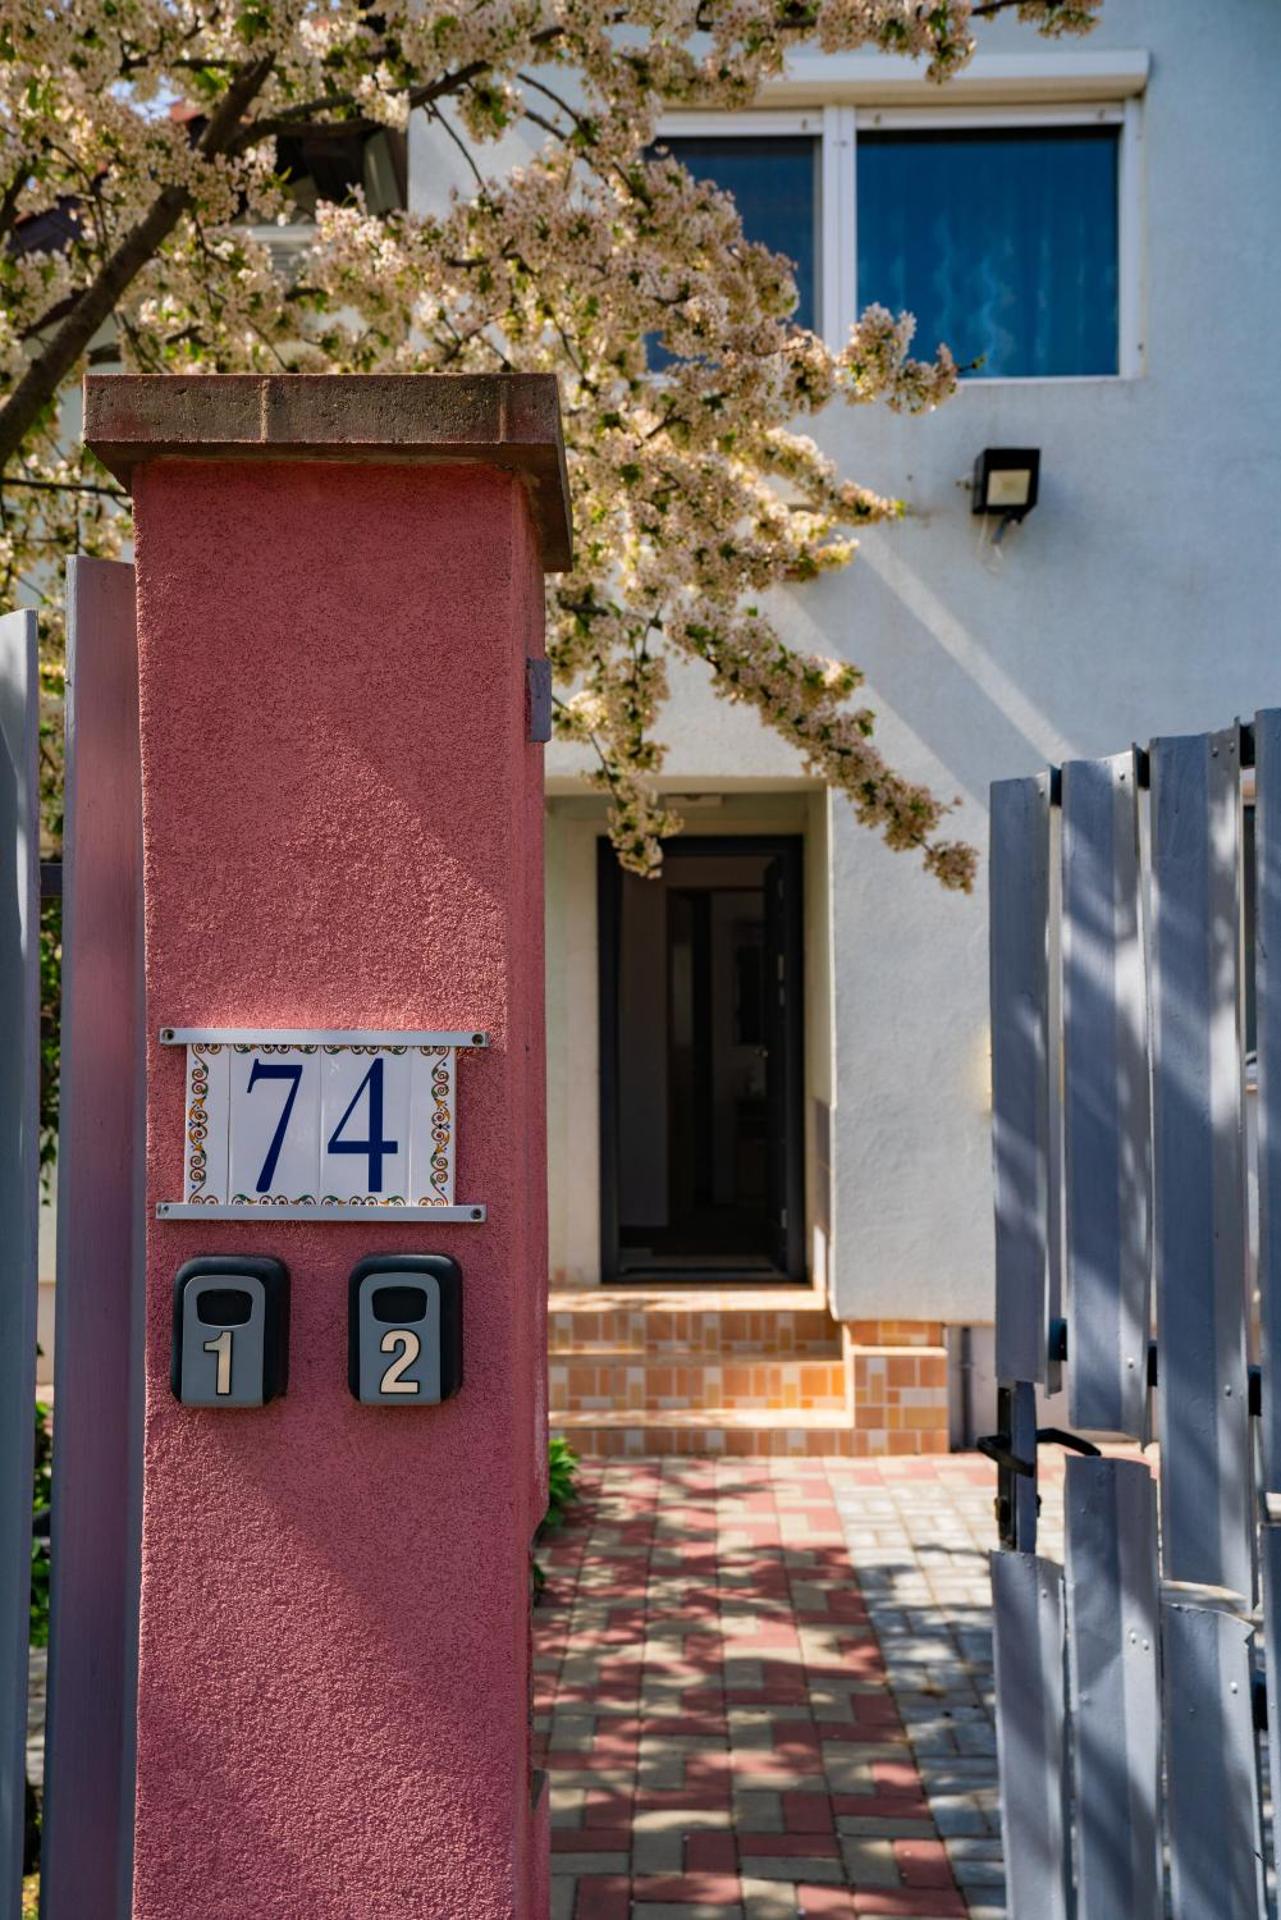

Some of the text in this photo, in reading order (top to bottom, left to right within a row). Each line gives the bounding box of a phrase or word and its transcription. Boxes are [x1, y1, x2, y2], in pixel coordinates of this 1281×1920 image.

[247, 1058, 398, 1192] 74
[203, 1330, 234, 1396] 1
[379, 1329, 422, 1395] 2
